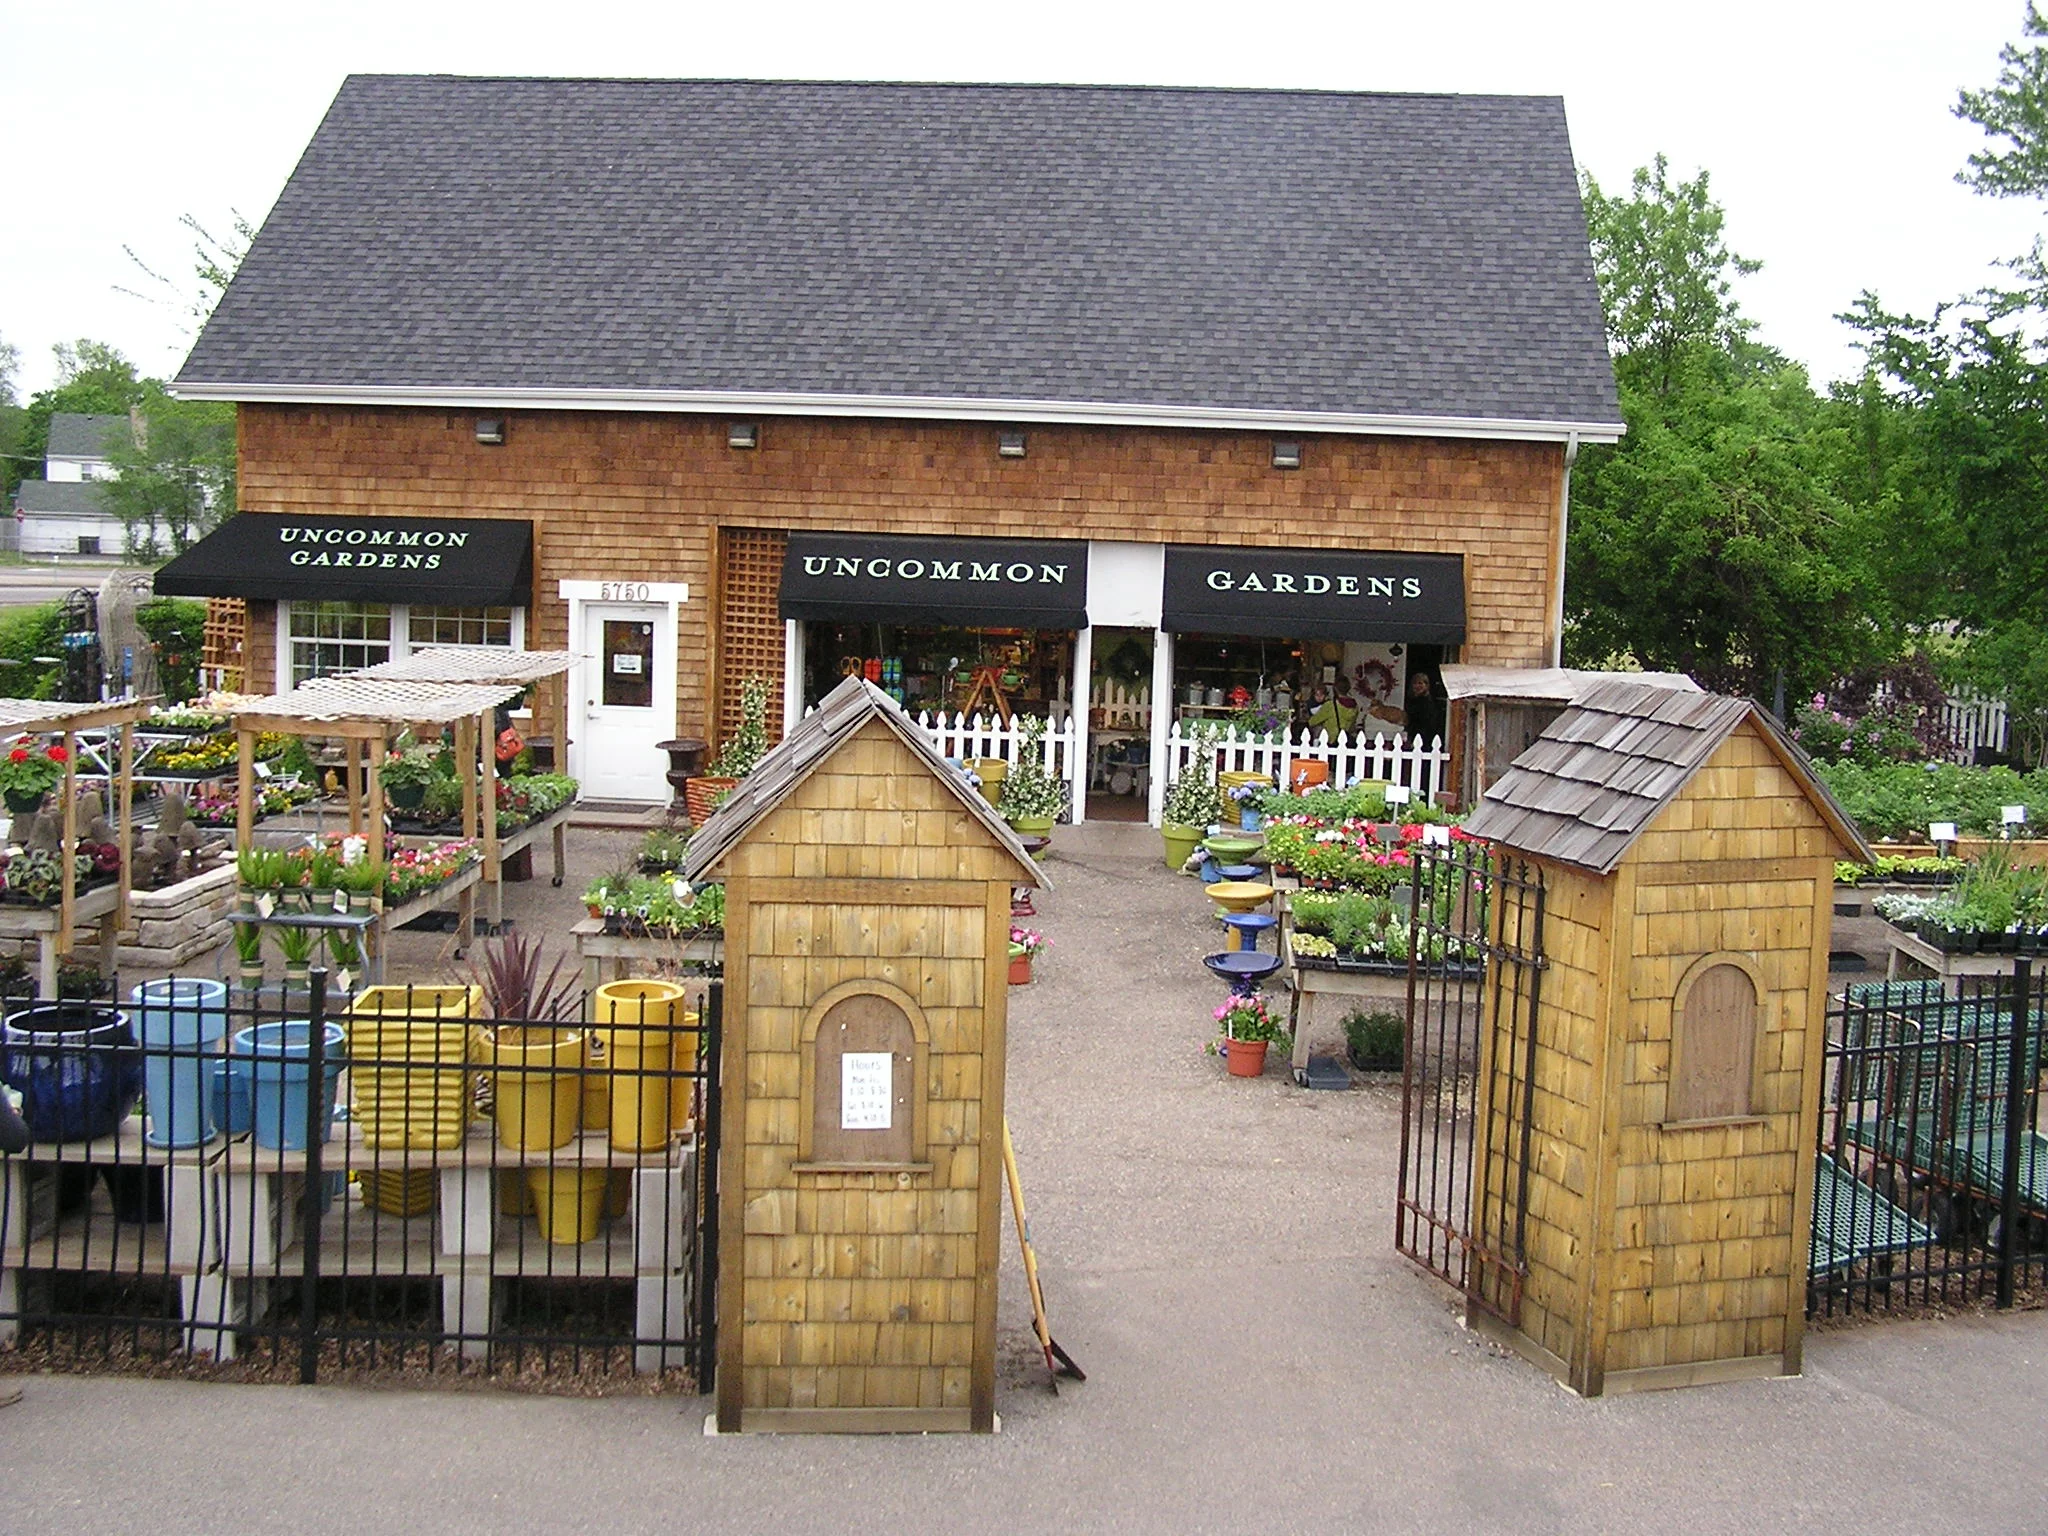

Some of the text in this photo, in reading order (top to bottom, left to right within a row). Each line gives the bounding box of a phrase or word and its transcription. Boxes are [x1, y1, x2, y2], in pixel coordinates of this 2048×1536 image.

[280, 527, 469, 547] UNCOMMON
[289, 550, 441, 569] GARDENS
[802, 556, 1422, 599] UNCOMMON GARDENS
[601, 582, 650, 602] 5750
